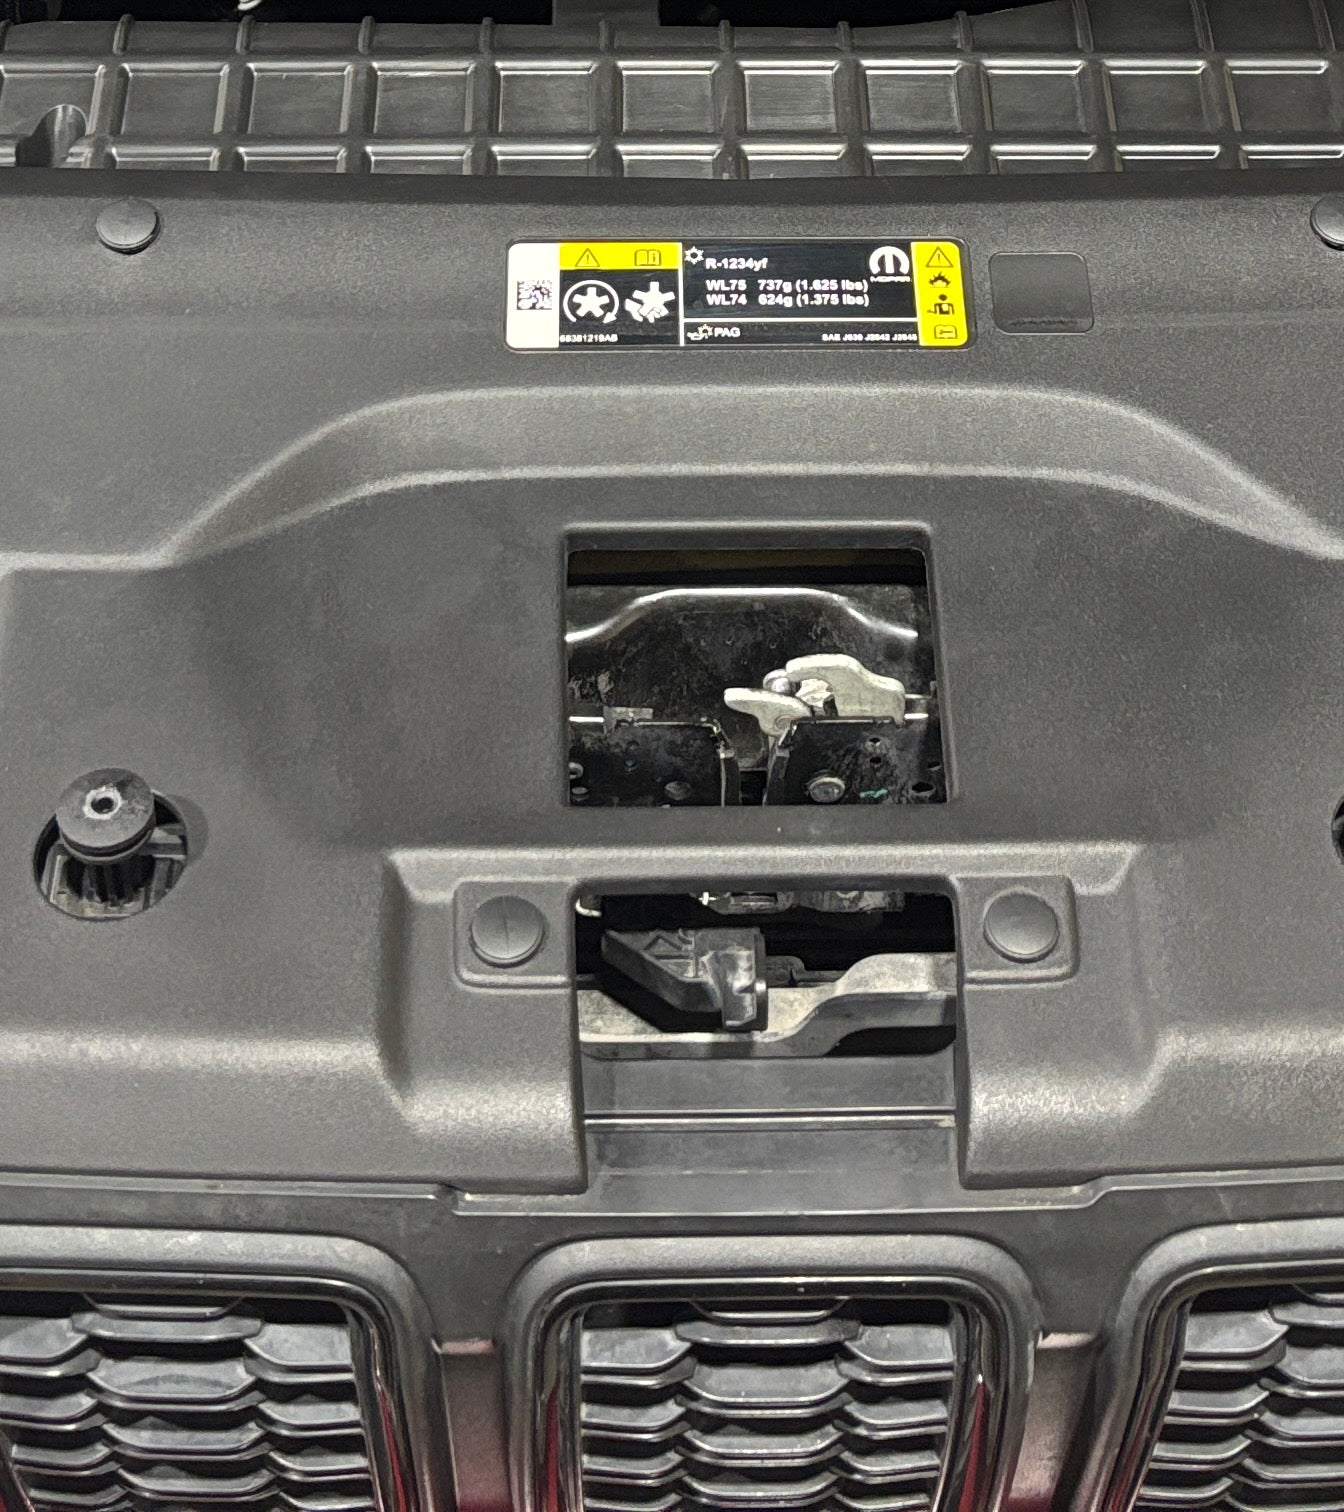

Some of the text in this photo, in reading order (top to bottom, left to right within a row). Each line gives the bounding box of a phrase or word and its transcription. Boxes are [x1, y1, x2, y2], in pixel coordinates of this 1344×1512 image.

[706, 257, 768, 272] R-1234yf
[706, 279, 869, 293] WL75 737g (1.625 lbs)
[706, 293, 870, 307] WL74 624g (1.375 lbs)
[714, 326, 741, 338] PAG
[822, 333, 841, 341] SAE
